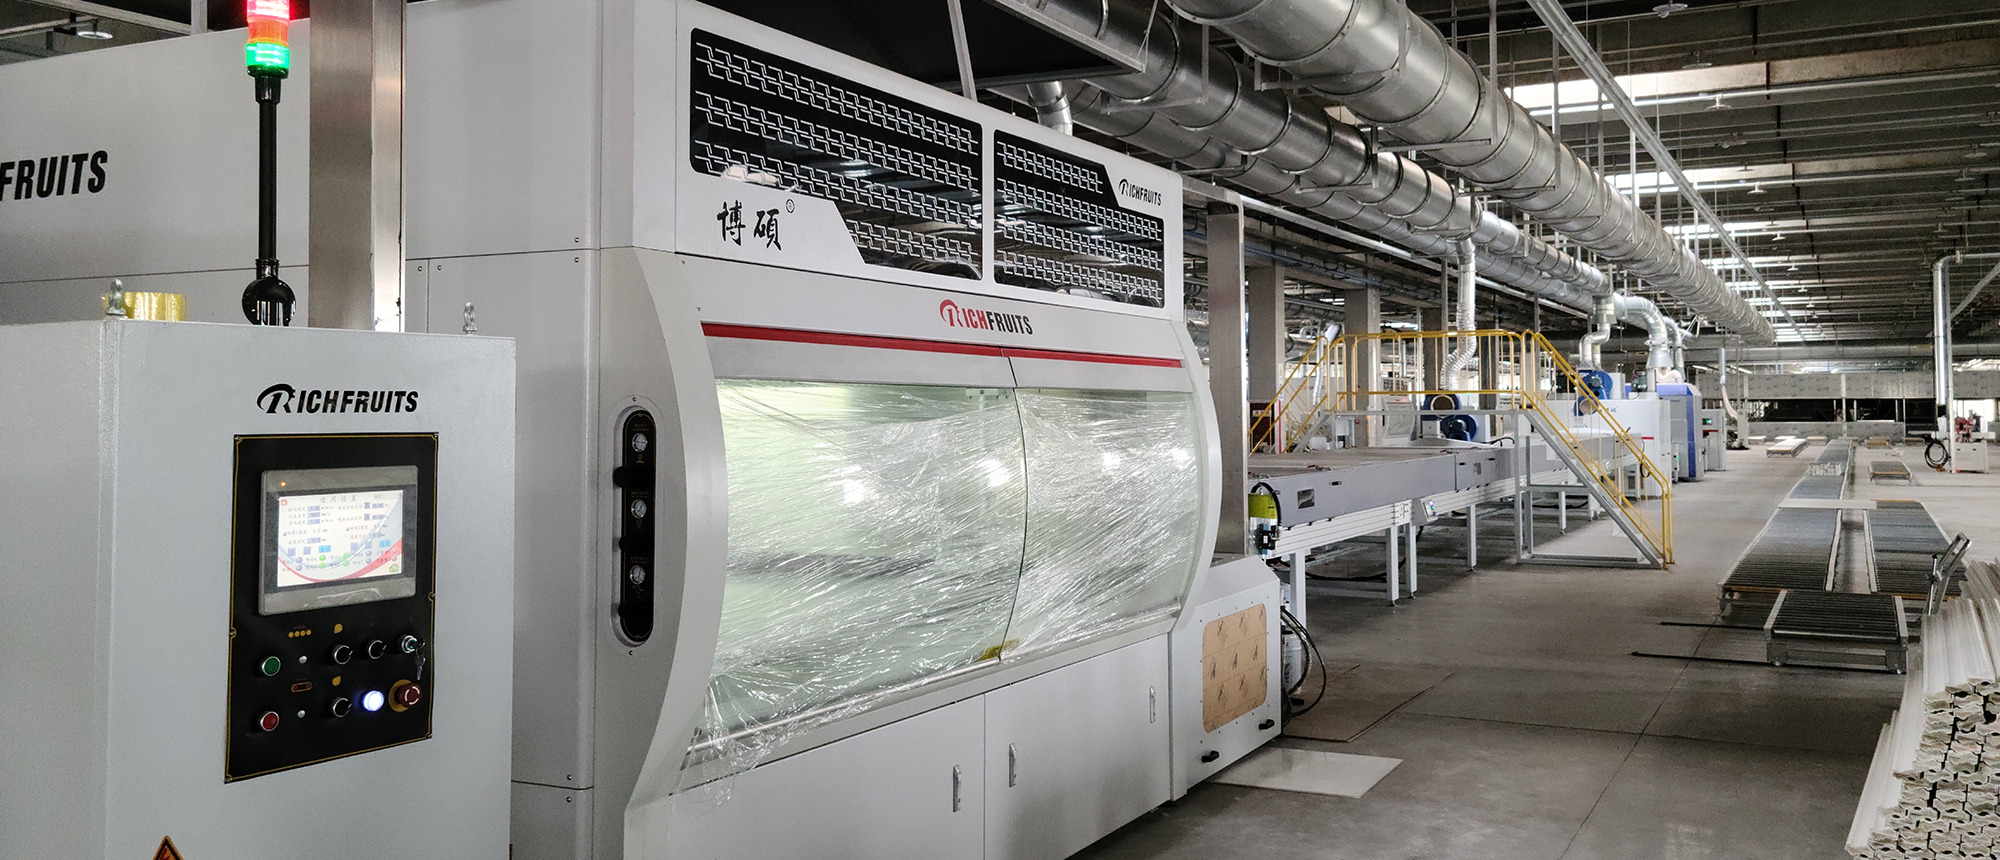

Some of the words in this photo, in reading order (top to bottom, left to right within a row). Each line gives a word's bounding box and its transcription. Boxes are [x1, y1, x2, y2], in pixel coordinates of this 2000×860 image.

[0, 150, 108, 201] FRUITS
[940, 299, 1033, 335] RICHFRUITS
[256, 383, 419, 413] RICHFRUITS
